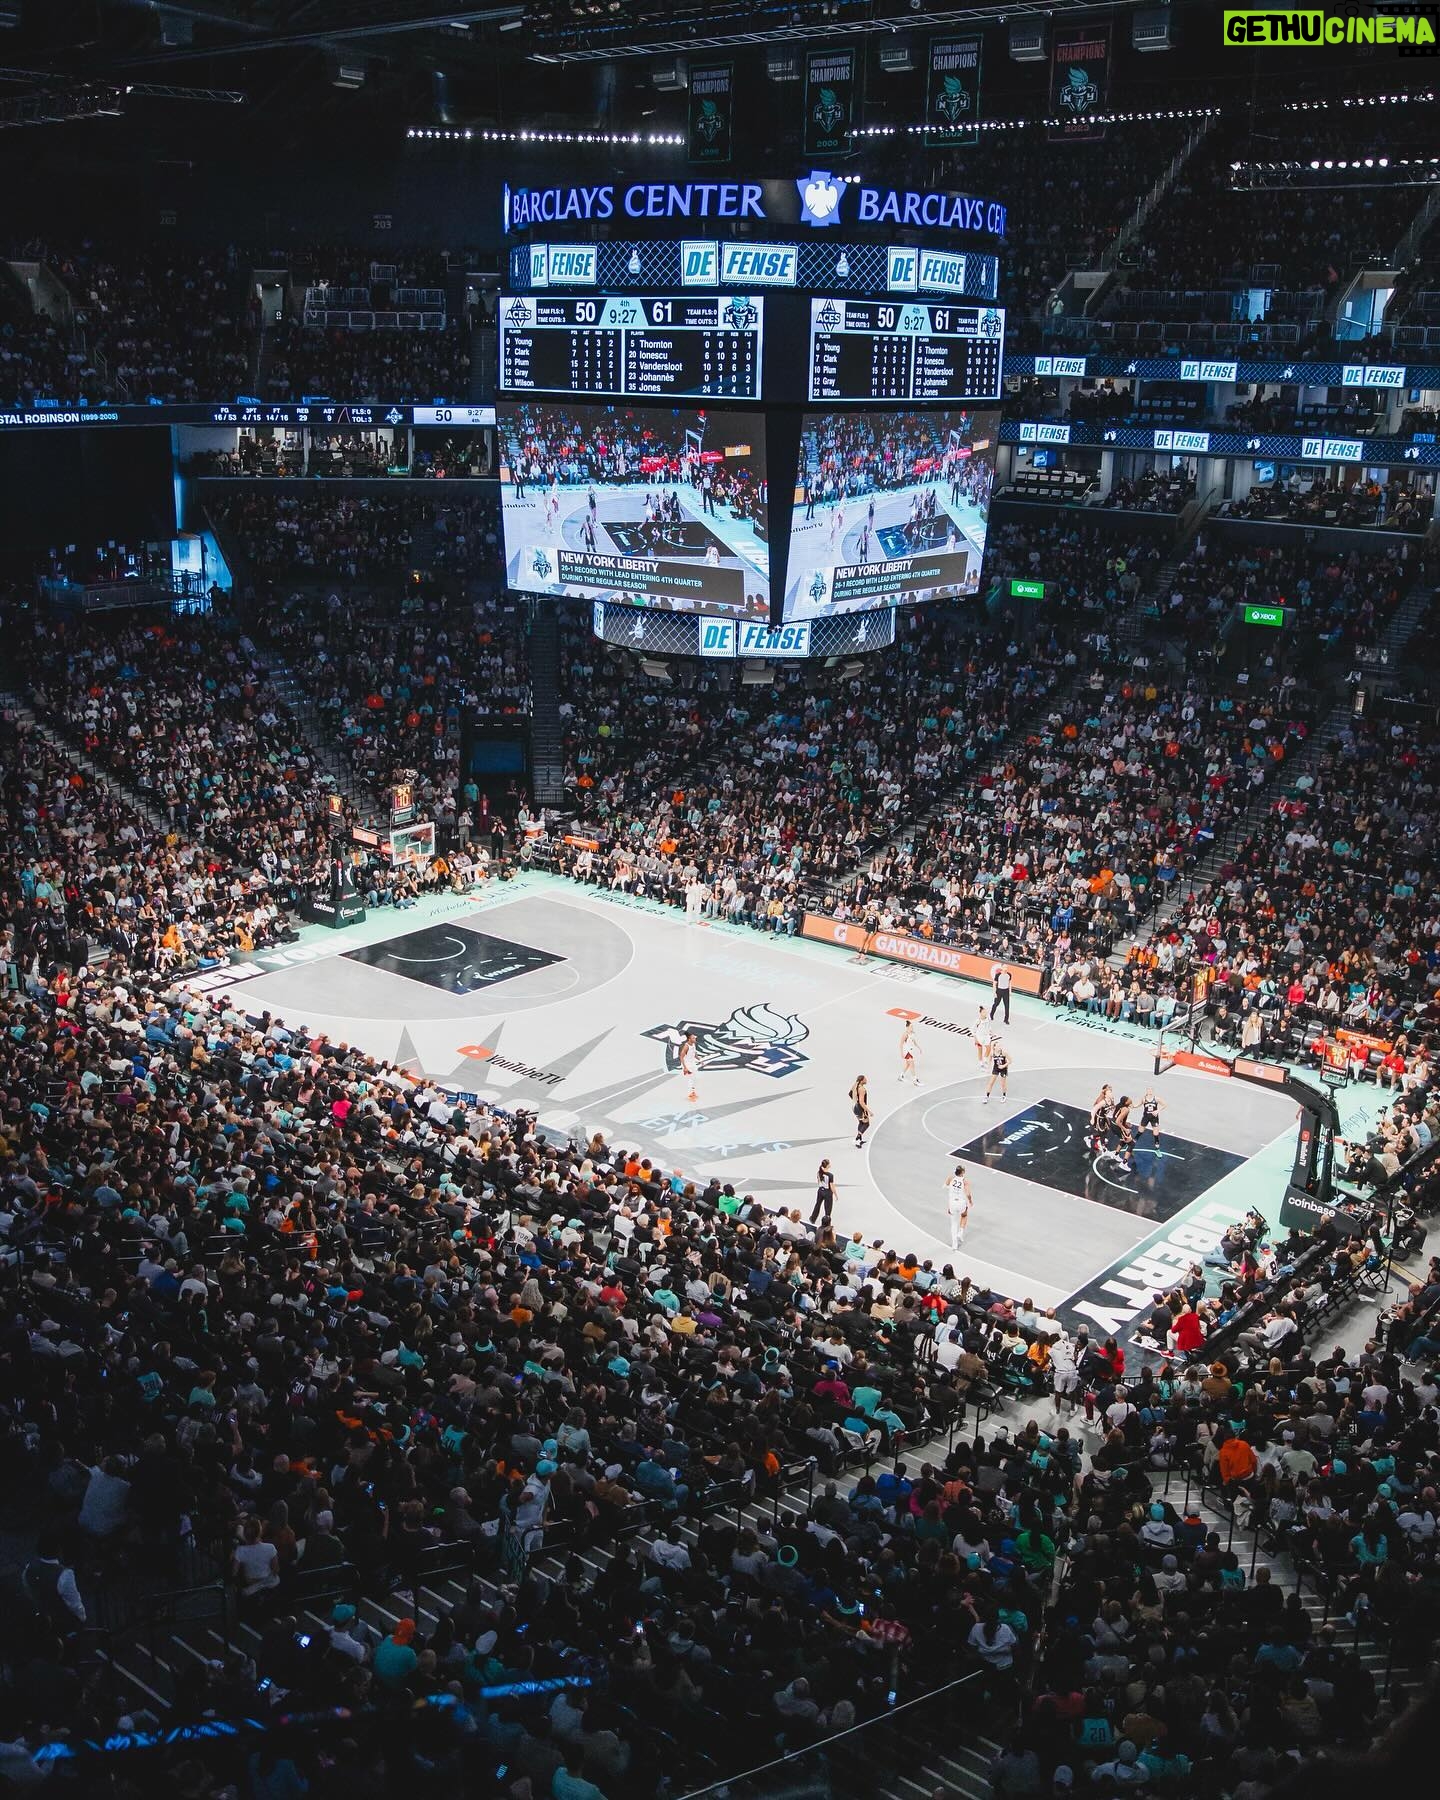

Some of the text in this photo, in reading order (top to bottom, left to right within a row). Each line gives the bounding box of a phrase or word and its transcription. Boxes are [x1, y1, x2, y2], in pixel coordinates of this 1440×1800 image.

[1057, 44, 1105, 62] CHAMPIONS
[933, 54, 977, 70] CHAMPIONS
[810, 67, 850, 83] CHAMPIONS
[693, 79, 729, 94] CHAMPIONS
[513, 184, 766, 223] BARCLAYS CENTER
[859, 189, 984, 231] BARCLAYS
[533, 252, 593, 278] DE FENSE
[686, 252, 794, 277] DE FENSE
[892, 257, 963, 285] DE FENSE
[506, 310, 531, 319] ACES
[576, 302, 595, 322] 50
[610, 310, 637, 323] 9:27
[652, 302, 672, 322] 61
[817, 314, 840, 322] ACES
[878, 308, 894, 328] 50
[904, 316, 924, 330] 9:27
[936, 310, 949, 330] 61
[515, 338, 532, 346] Young
[640, 340, 672, 348] Thornton
[640, 351, 668, 360] Ionescu
[515, 369, 528, 377] Gray
[639, 362, 682, 371] Vandersloot
[1037, 360, 1084, 373] DE FENSE
[1184, 365, 1234, 378] DE FENSE
[1345, 370, 1403, 384] DE FENSE
[25, 414, 79, 423] ROBINSON
[435, 409, 452, 422] 50
[1023, 427, 1069, 440] DE FENSE
[1157, 434, 1207, 448] DE FENSE
[1304, 442, 1361, 457] DE FENSE
[561, 551, 659, 573] NEW YORK LIBERTY
[836, 560, 913, 579] NEW YORK LIBERTY
[562, 574, 582, 582] DURING
[596, 577, 622, 587] REGULAR
[623, 580, 647, 590] SEASON
[574, 566, 597, 575] RECORD
[599, 568, 613, 576] WITH
[615, 570, 630, 578] LEAD
[630, 572, 660, 582] ENTERING
[661, 575, 672, 583] 4TH
[674, 576, 702, 588] QUARTER
[846, 578, 865, 587] RECORD
[878, 575, 890, 583] LEAD
[890, 572, 912, 581] ENTERING
[920, 569, 940, 578] QUARTER
[834, 590, 851, 598] DURING
[862, 585, 882, 594] REGULAR
[882, 583, 901, 592] SEASON
[1260, 613, 1277, 621] XBOX
[704, 625, 807, 650] DE FENSE
[313, 902, 335, 913] coinbase
[875, 936, 960, 970] GATORADE
[1064, 1018, 1136, 1039] FINALS
[999, 1123, 1039, 1145] WNBA
[952, 1180, 962, 1189] 22
[1288, 1196, 1336, 1218] coinbase
[1072, 1202, 1245, 1335] LIBERTY
[1349, 1424, 1357, 1434] 31
